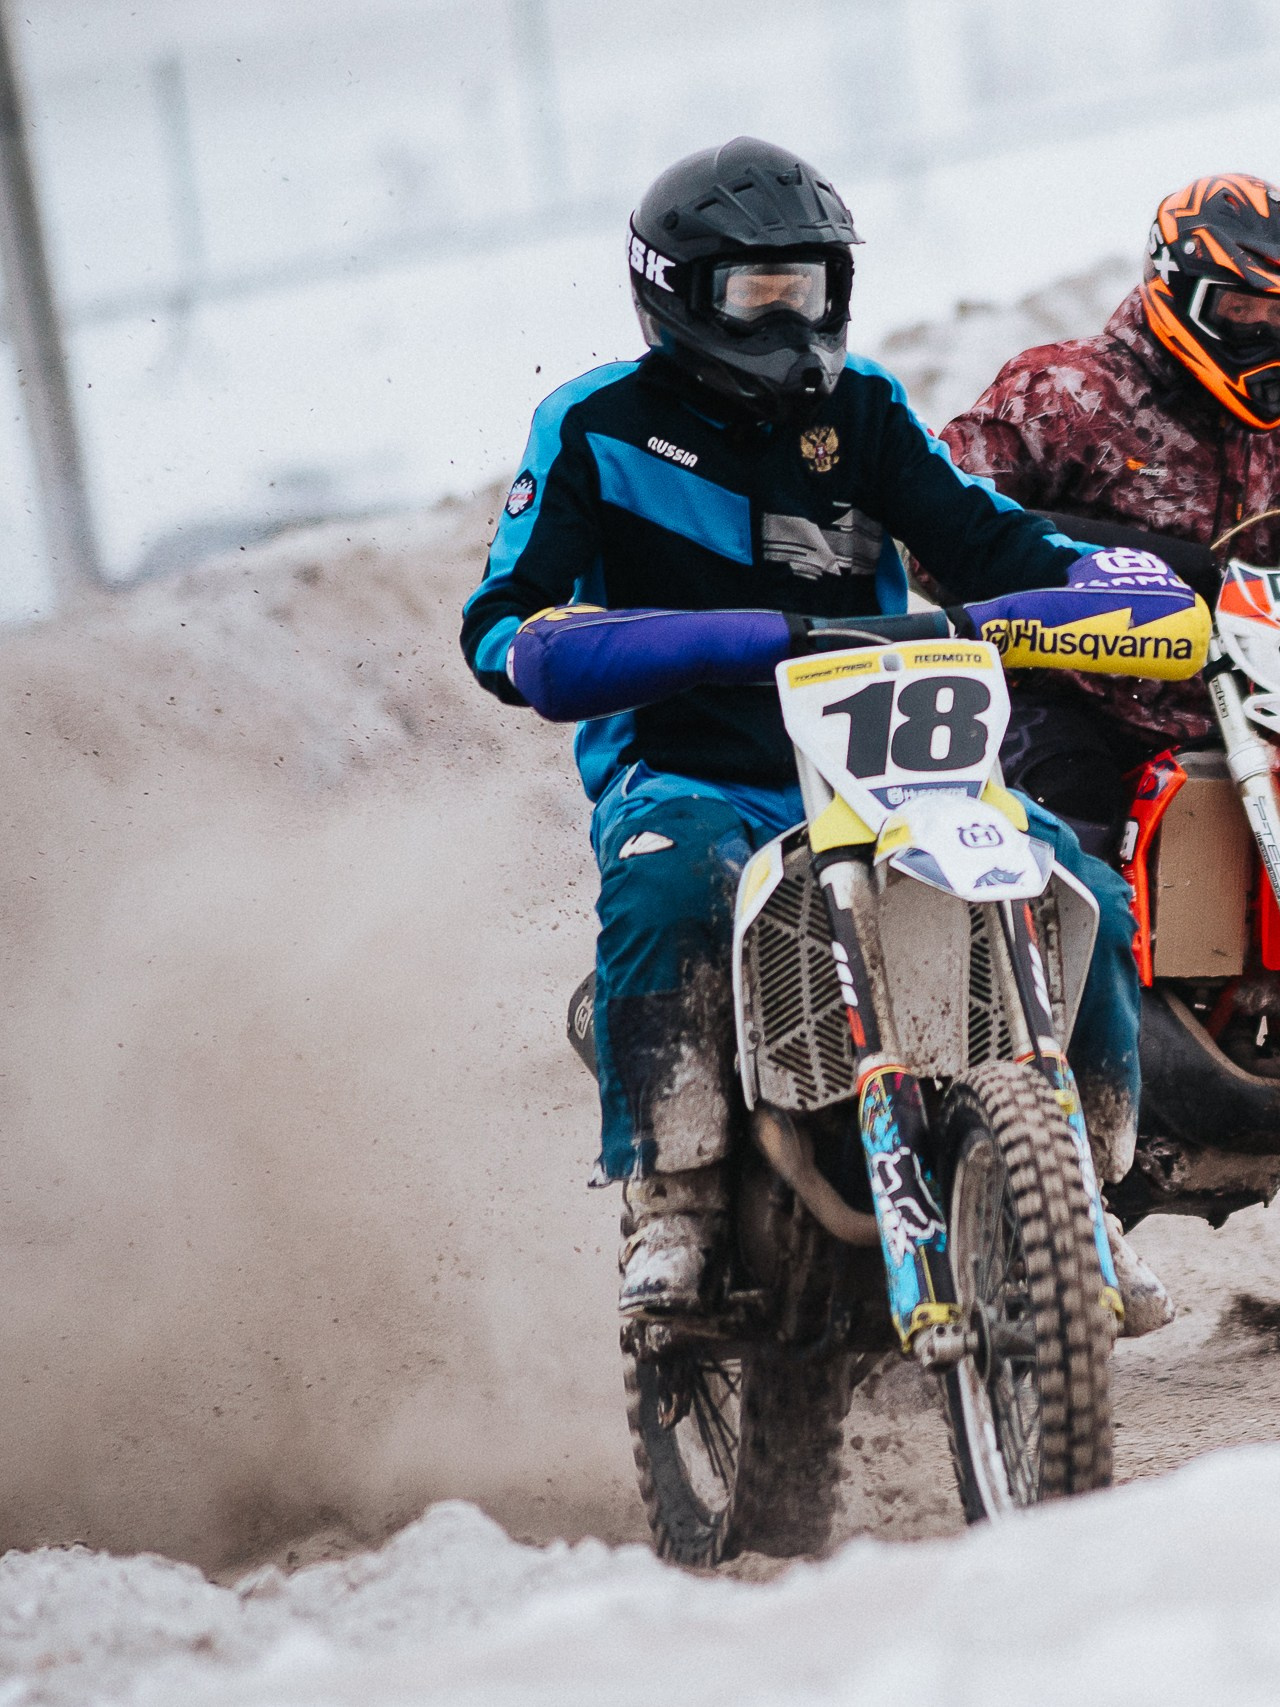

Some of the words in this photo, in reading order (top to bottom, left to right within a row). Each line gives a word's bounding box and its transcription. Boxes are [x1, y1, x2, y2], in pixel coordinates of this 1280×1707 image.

[647, 436, 698, 468] RUSSIA
[1012, 622, 1193, 661] Husqvarna
[822, 675, 991, 780] 18
